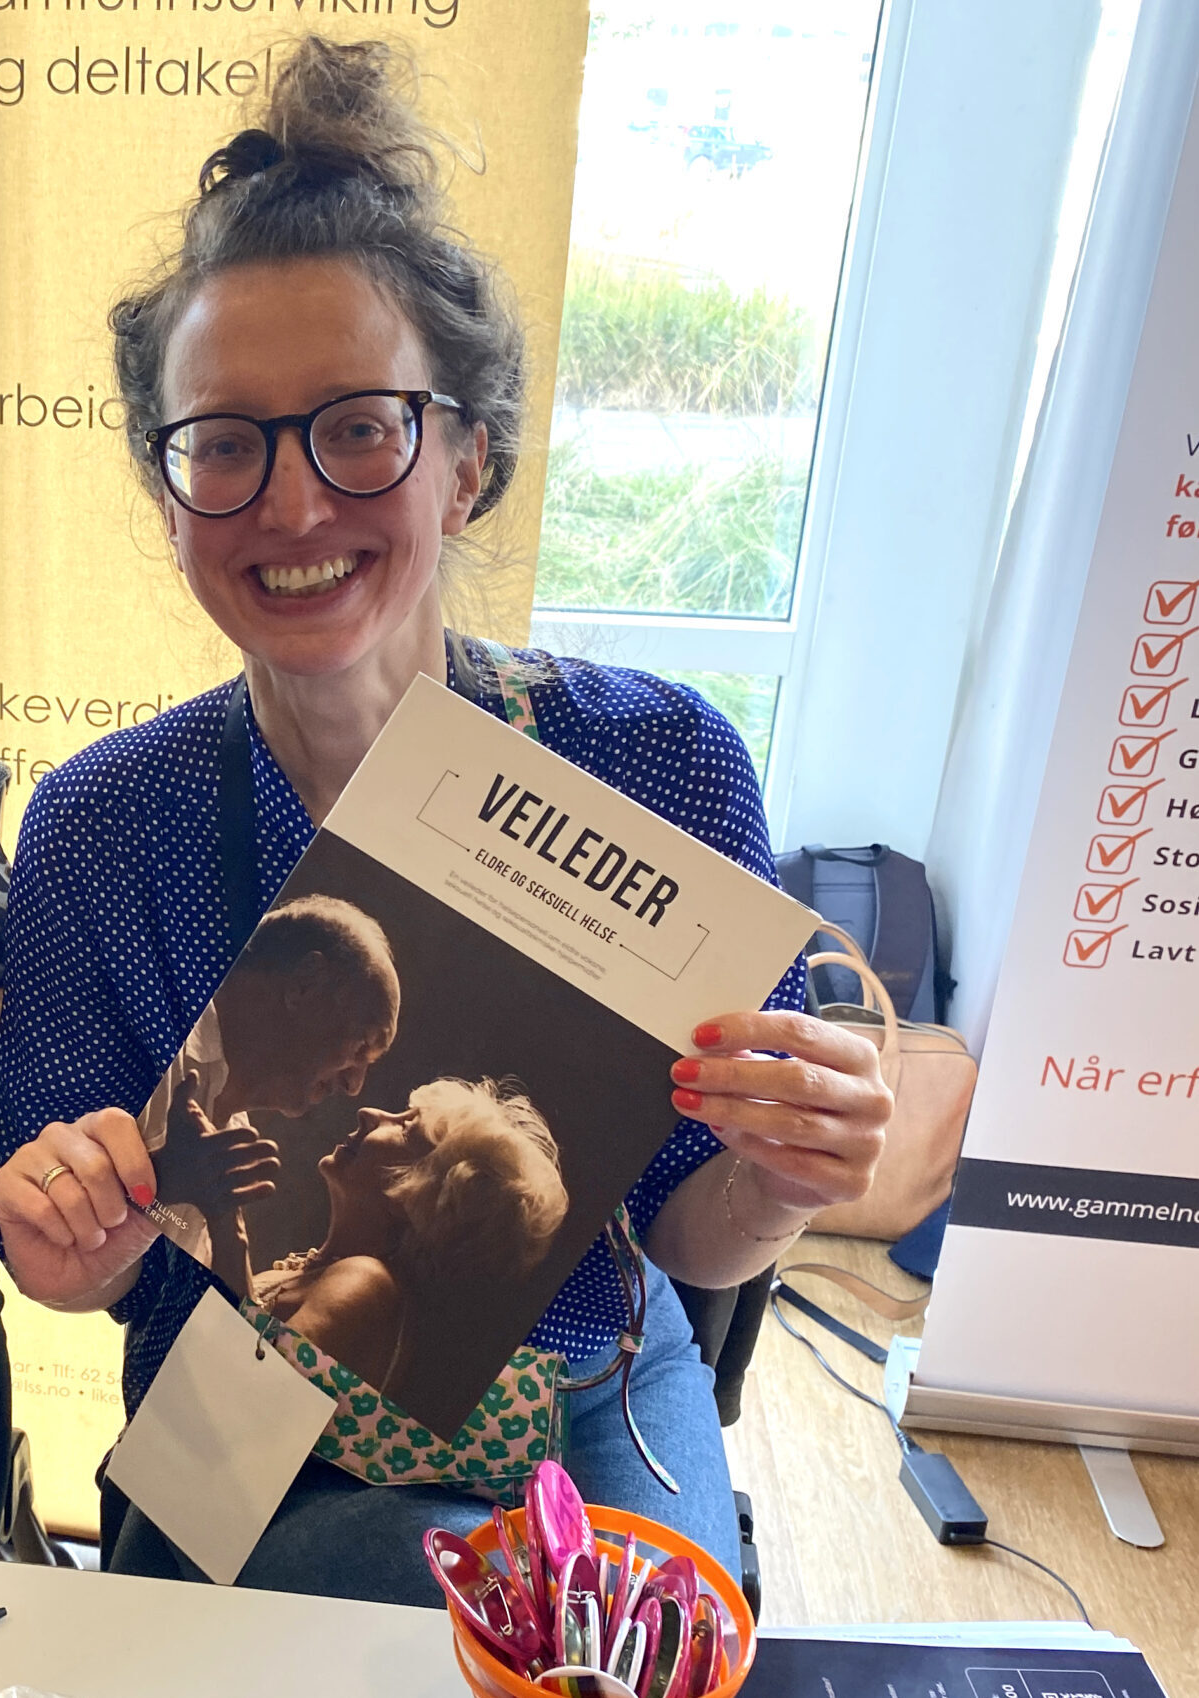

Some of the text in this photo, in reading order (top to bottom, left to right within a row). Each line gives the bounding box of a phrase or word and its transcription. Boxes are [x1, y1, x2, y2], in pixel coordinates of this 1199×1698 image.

[1166, 514, 1199, 538] fø
[478, 773, 679, 927] VEILEDER
[475, 848, 617, 944] ELDRE OG SEKSUELL HELSE
[1132, 940, 1196, 962] Lavt
[1040, 1055, 1125, 1092] Når
[142, 1206, 167, 1225] ERET
[80, 1368, 100, 1383] 62
